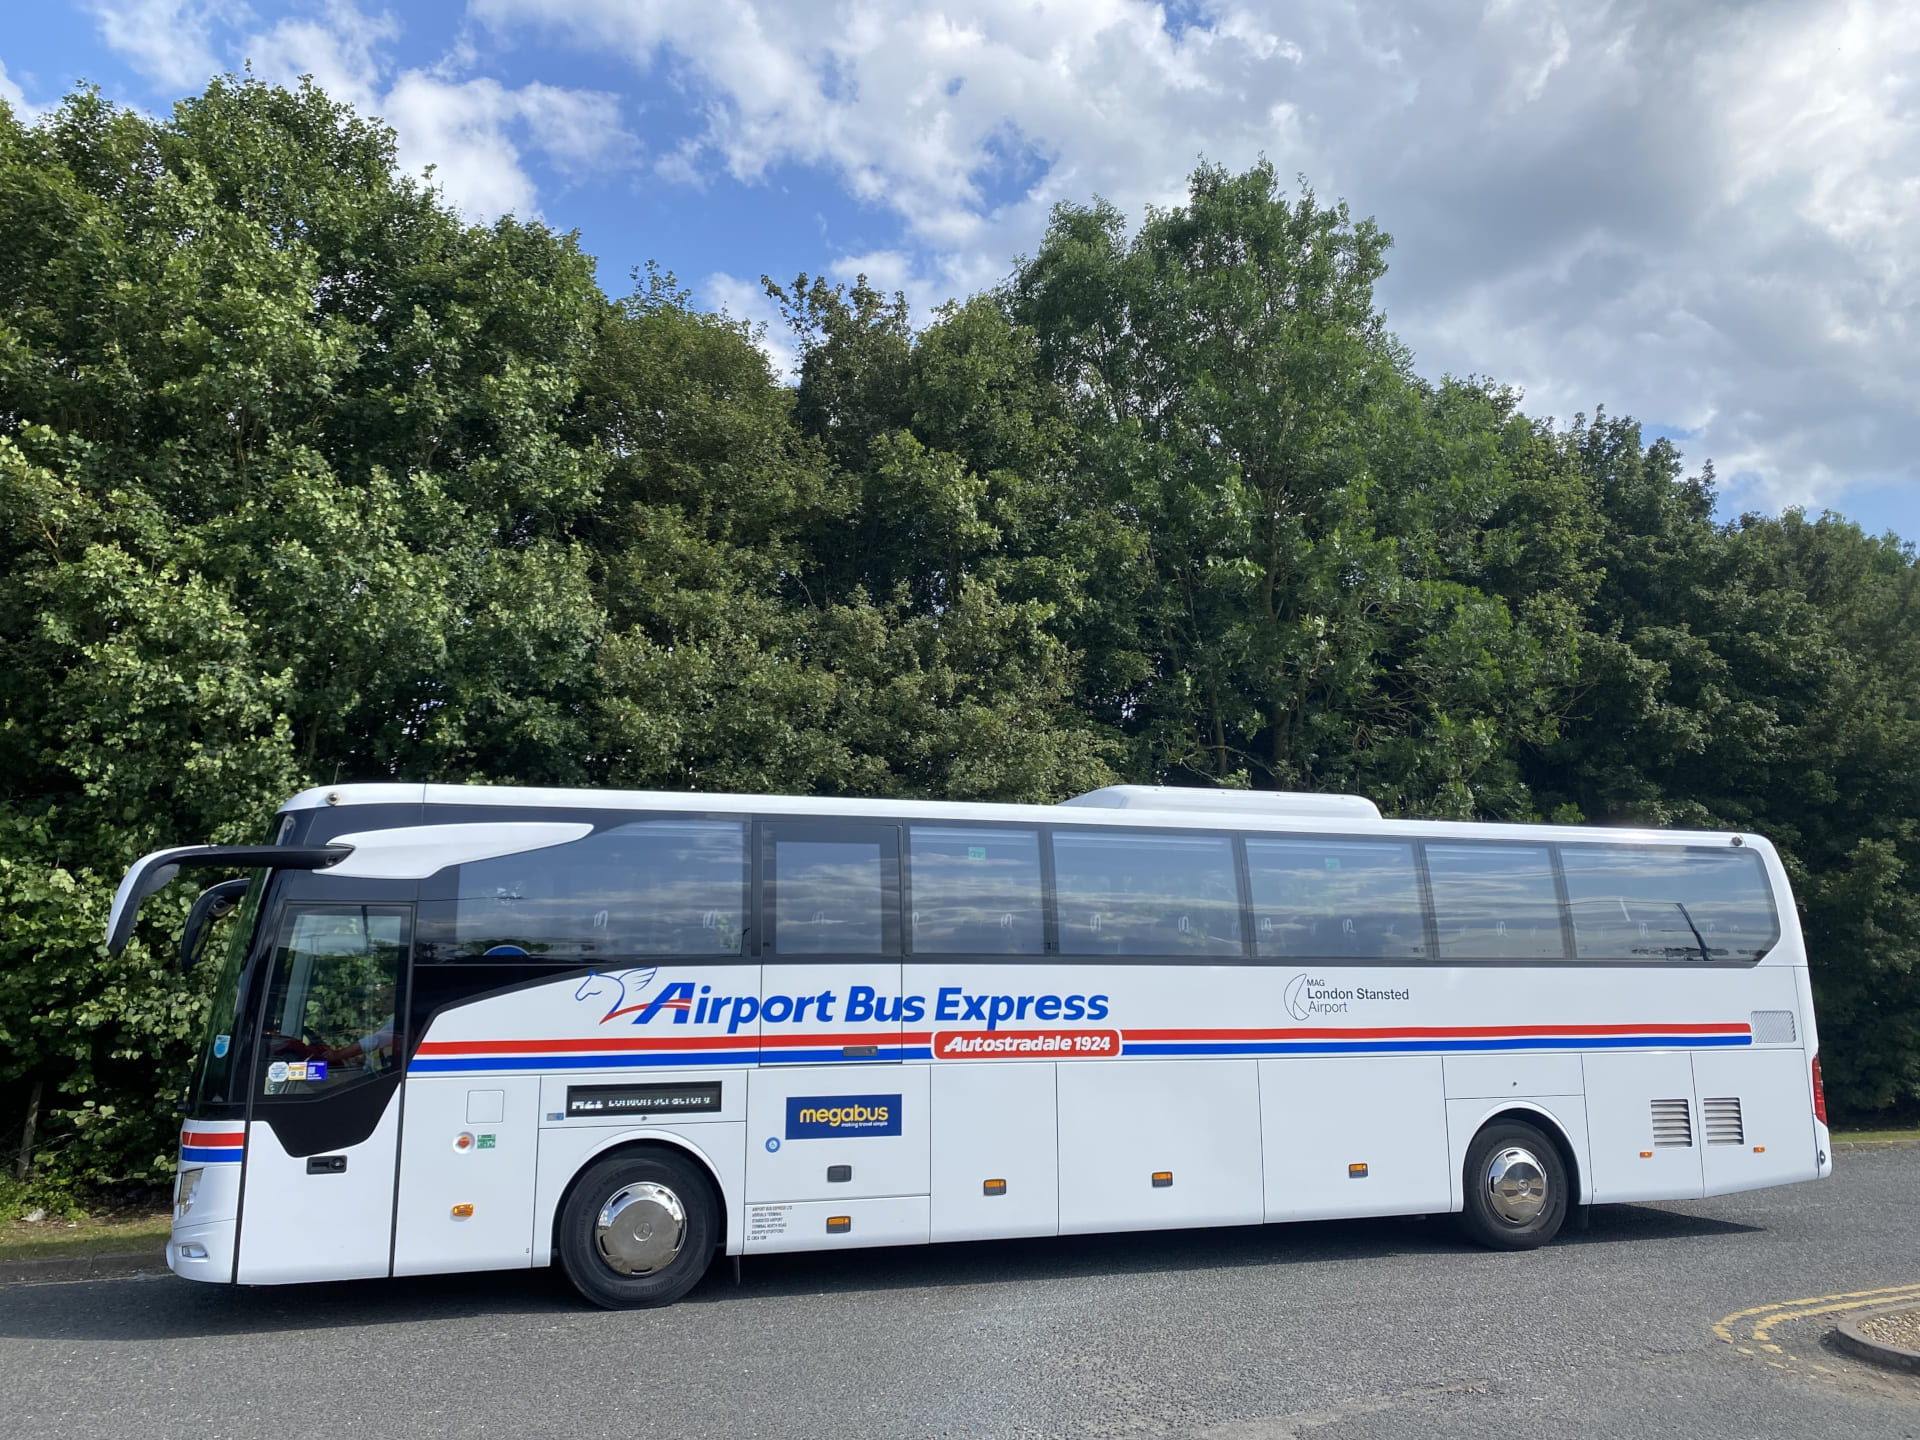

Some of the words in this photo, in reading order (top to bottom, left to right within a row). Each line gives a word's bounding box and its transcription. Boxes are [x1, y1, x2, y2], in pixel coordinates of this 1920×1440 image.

[1306, 979, 1326, 987] MAG
[1307, 987, 1354, 1000] London
[1356, 987, 1410, 1001] Stansted
[631, 982, 838, 1034] Airport
[844, 985, 926, 1022] Bus
[935, 987, 1110, 1032] Express
[1308, 1001, 1349, 1016] Airport
[944, 1036, 1076, 1053] Autostradale
[1073, 1036, 1112, 1051] 1924
[799, 1103, 889, 1127] megabus
